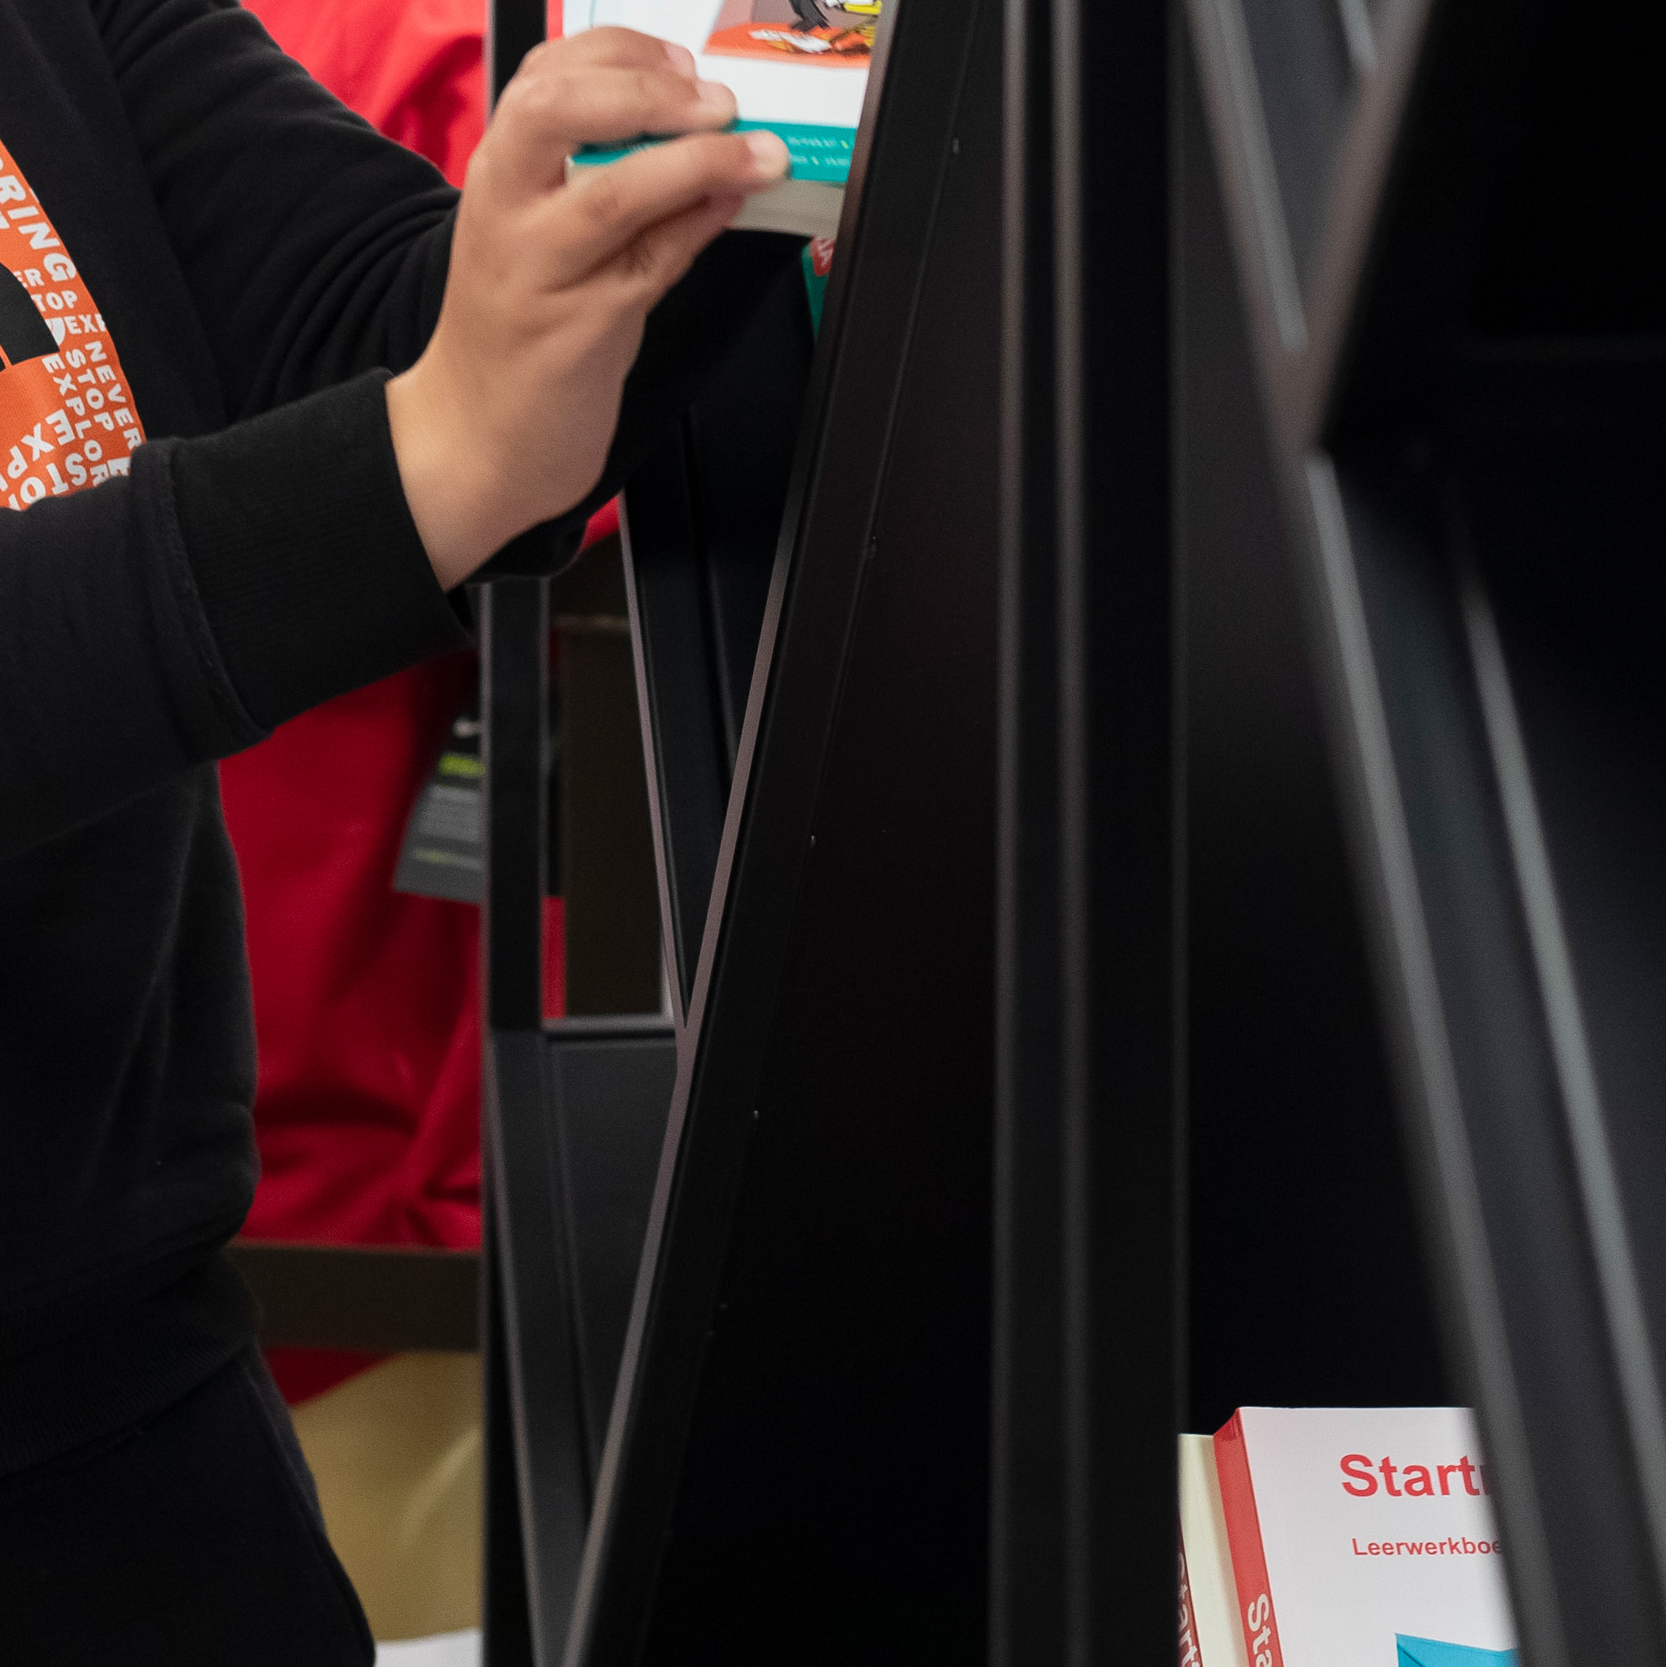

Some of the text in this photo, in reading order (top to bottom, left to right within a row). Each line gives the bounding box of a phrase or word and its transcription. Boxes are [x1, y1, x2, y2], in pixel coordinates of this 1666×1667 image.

[26, 290, 78, 313] TOP
[65, 349, 115, 432] STOP
[85, 340, 143, 450] NEVER
